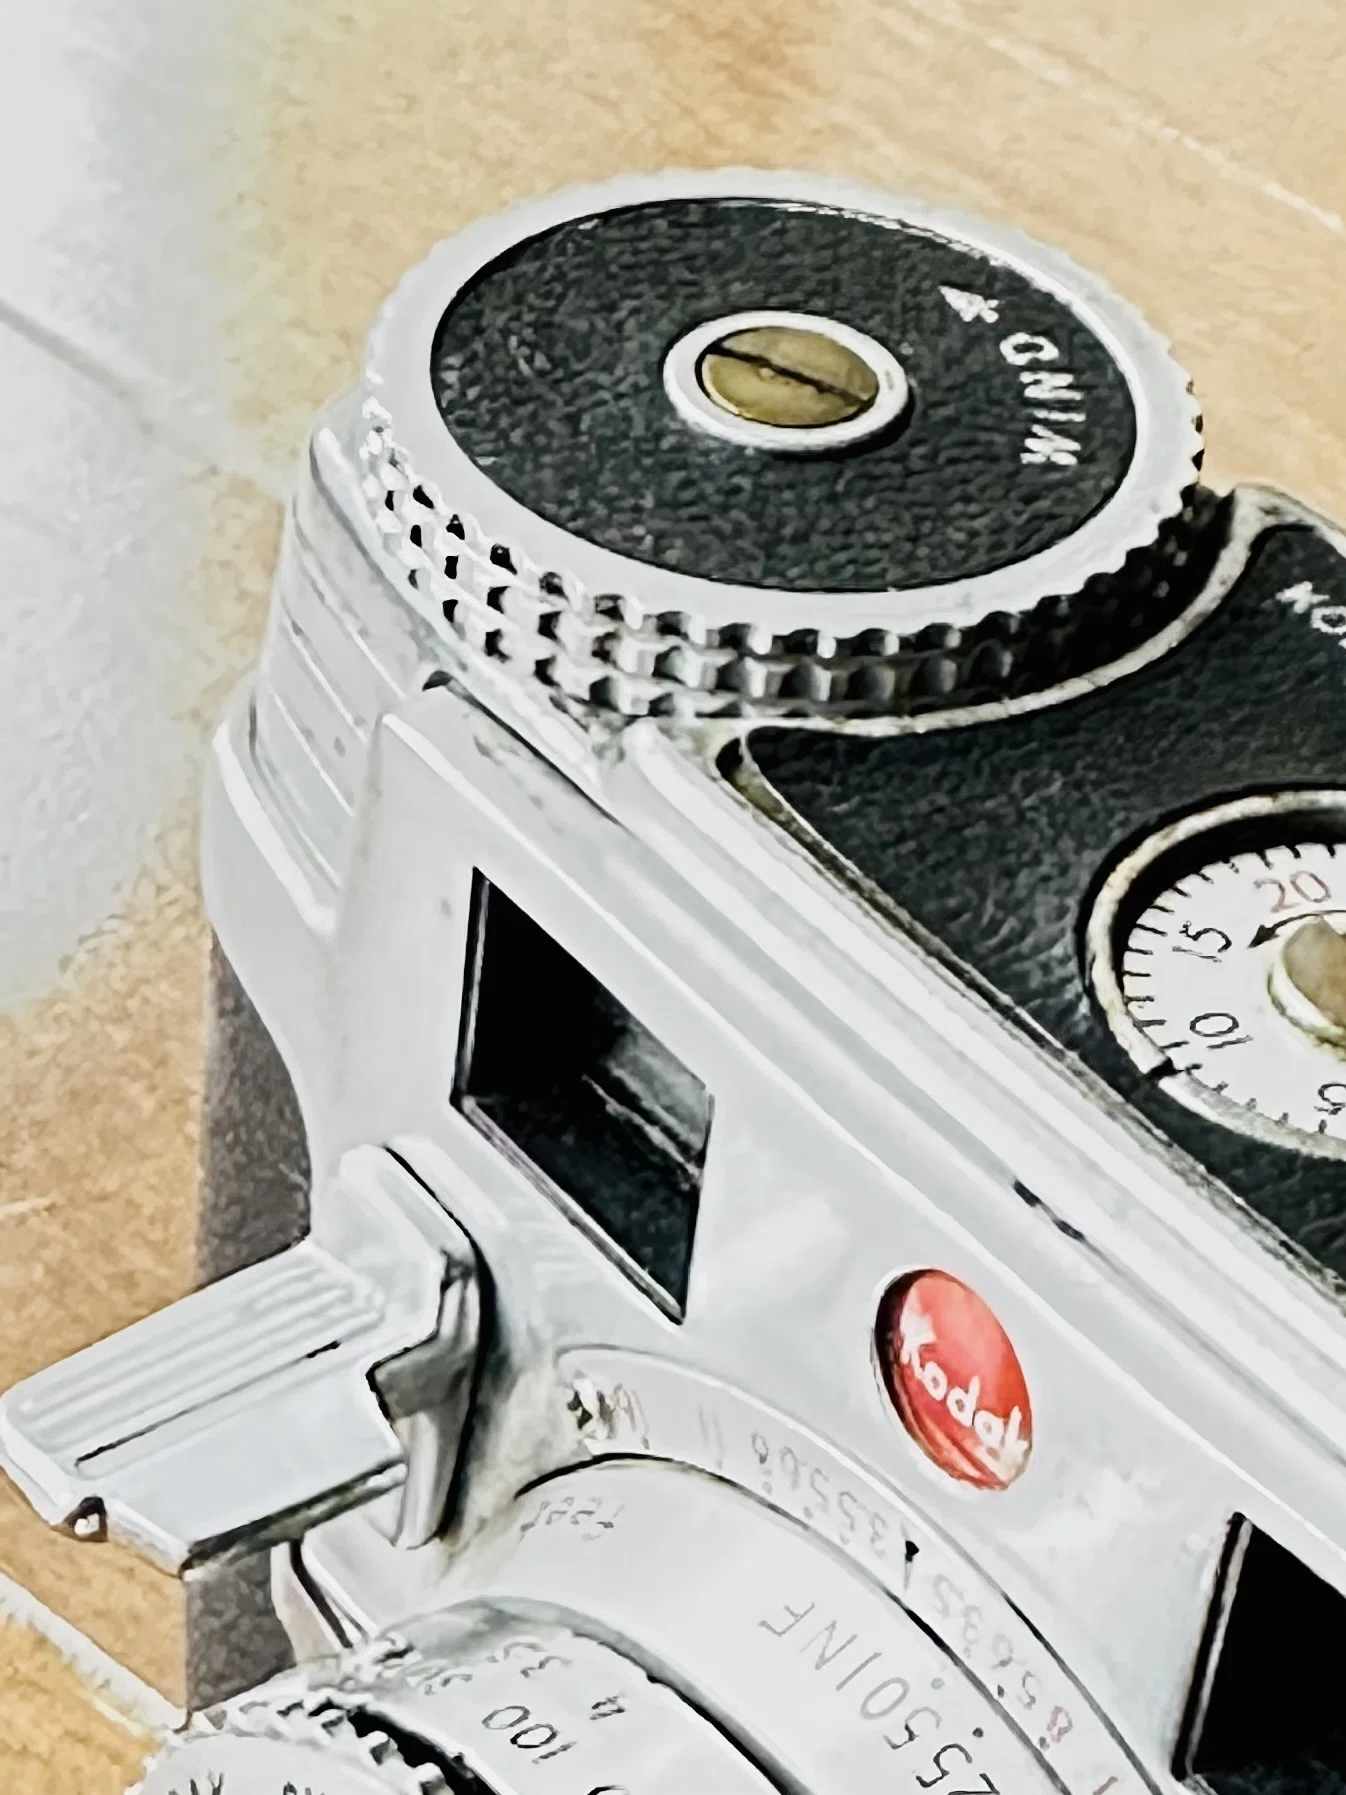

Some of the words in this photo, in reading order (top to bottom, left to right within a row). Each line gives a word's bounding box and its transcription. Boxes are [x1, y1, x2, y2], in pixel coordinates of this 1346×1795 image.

[999, 332, 1086, 465] WIND
[1254, 870, 1332, 912] 20
[1171, 920, 1233, 963] 15
[1189, 1012, 1254, 1050] 10
[900, 1308, 1030, 1475] Kodak
[757, 1602, 883, 1692] INF
[482, 1705, 578, 1764] 100
[859, 1677, 943, 1750] 50
